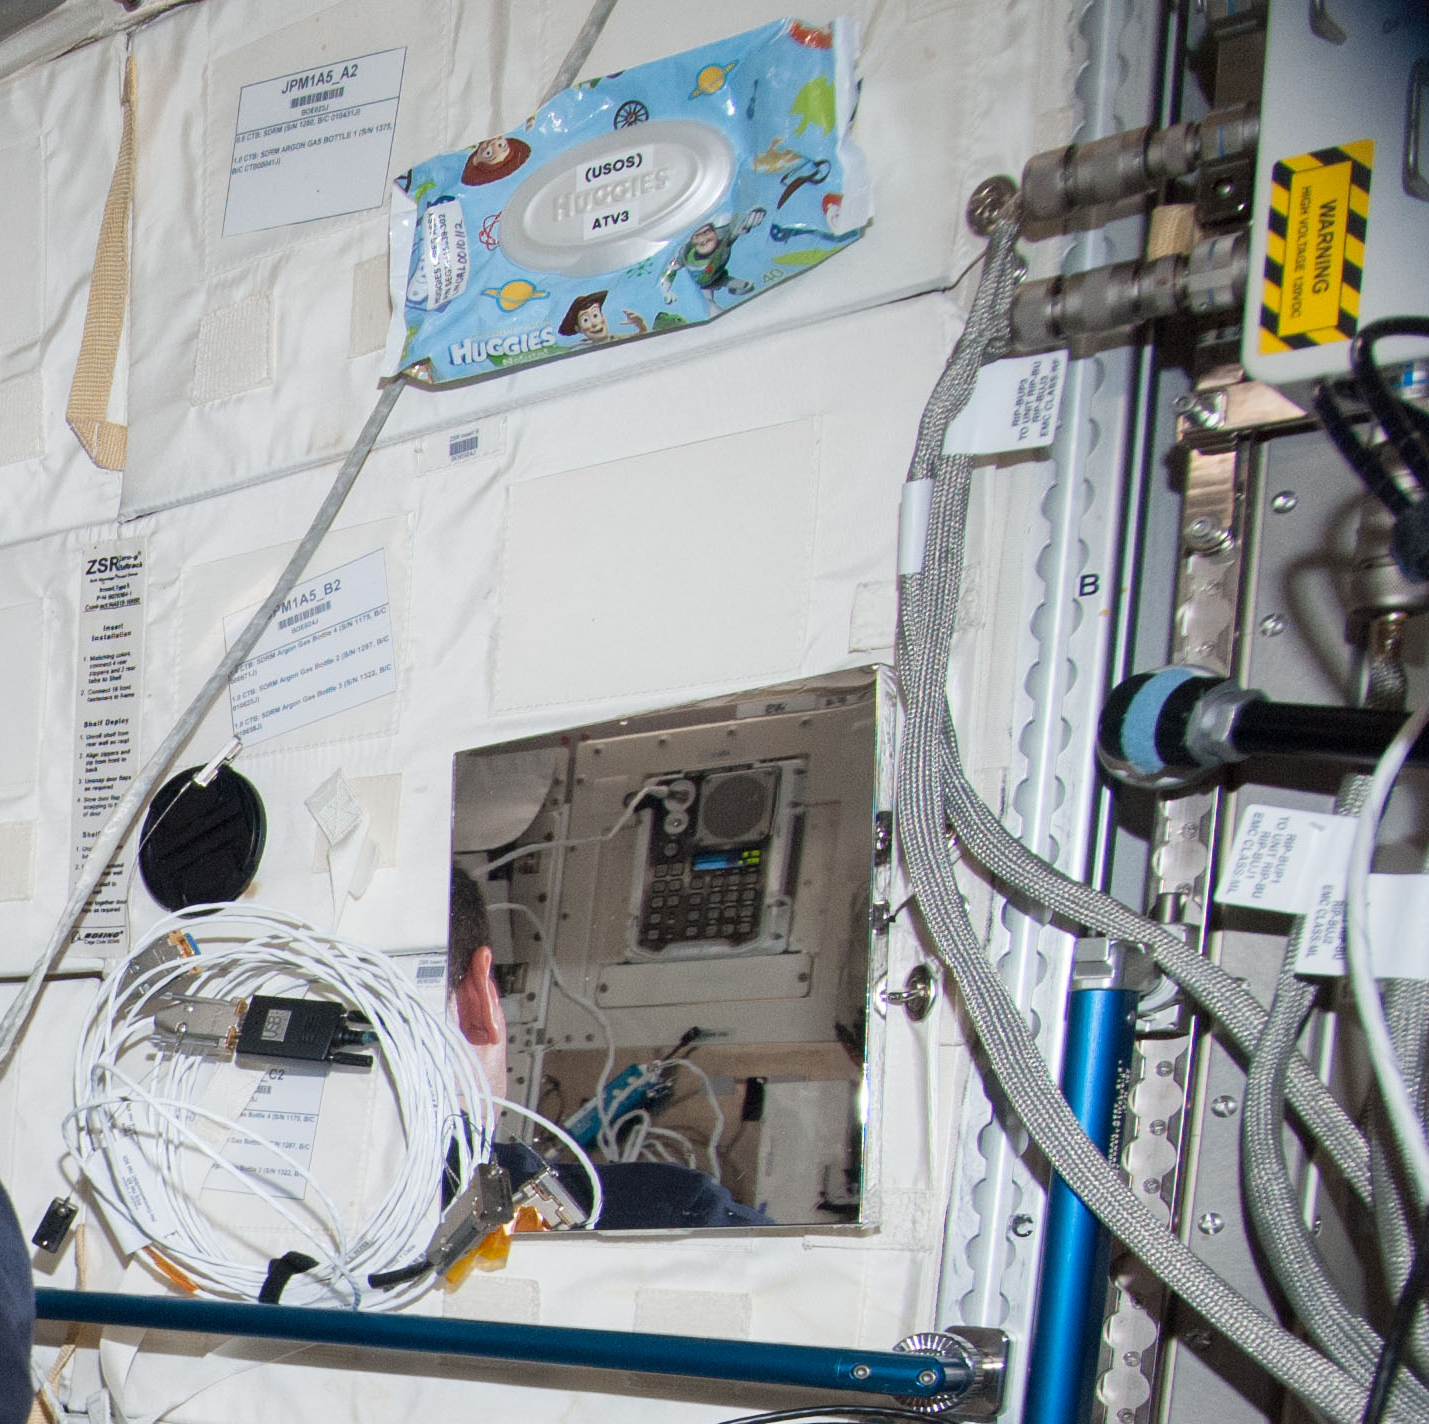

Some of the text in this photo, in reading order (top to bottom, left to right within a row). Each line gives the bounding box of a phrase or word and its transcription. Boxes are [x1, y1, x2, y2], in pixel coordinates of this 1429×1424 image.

[281, 64, 358, 94] JPM1A5_A2
[323, 131, 352, 145] BOTTLE
[585, 153, 643, 182] (USOS)
[592, 210, 630, 230] ATV3
[1291, 186, 1312, 318] HIGH VOLTAGE 120VDC
[1312, 199, 1336, 294] WARNING
[449, 326, 557, 365] HUGGIES
[1019, 360, 1042, 440] TO UNIT RIP-BU
[1040, 414, 1051, 437] EMC
[86, 556, 118, 575] ZSR
[1079, 574, 1099, 597] B
[271, 579, 341, 617] PM1A5_B2
[92, 631, 131, 642] Installation
[103, 623, 123, 631] Insert
[277, 645, 296, 657] Argon
[298, 638, 311, 648] Gas
[280, 672, 299, 684] Argon
[300, 665, 313, 675] Gas
[282, 698, 301, 712] Argon
[303, 693, 316, 703] Gas
[84, 718, 129, 728] Shelf Deploy
[1247, 812, 1265, 836] EMC
[1252, 816, 1290, 899] TO UNIT RIP-BU
[1319, 884, 1333, 906] EMC
[84, 931, 121, 939] BOEING
[264, 1014, 282, 1039] USB
